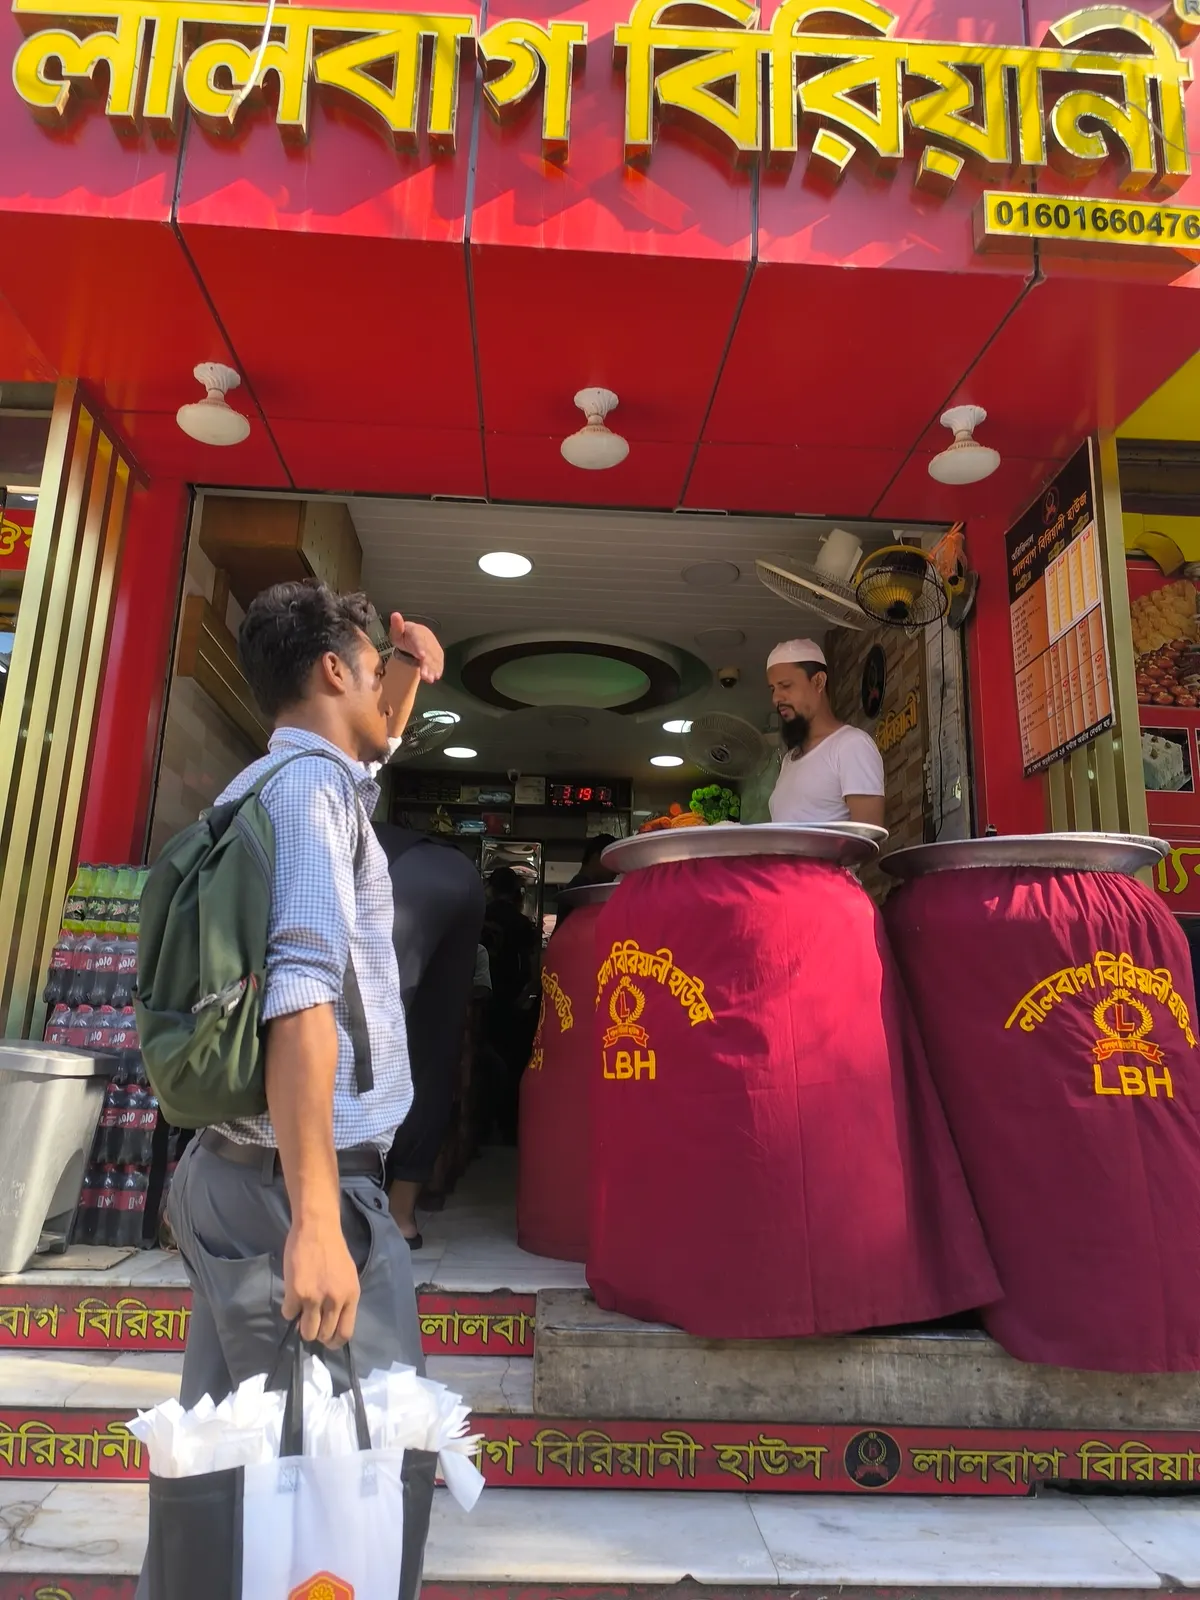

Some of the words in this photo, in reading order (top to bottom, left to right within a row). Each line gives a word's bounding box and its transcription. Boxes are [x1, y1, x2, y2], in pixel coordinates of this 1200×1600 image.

[11, 0, 588, 141] লালবাগ
[614, 0, 1193, 175] বিরিয়ানী
[996, 200, 1200, 240] 01601660476
[610, 940, 673, 985] বিরিয়ানী
[1004, 963, 1096, 1032] লালবাগ
[1094, 951, 1173, 1004] বিরিয়ানী
[602, 1050, 656, 1080] LBH
[1093, 1063, 1174, 1098] LBH
[531, 1429, 703, 1478] বিরিয়ানী
[712, 1434, 829, 1484] হাউস
[910, 1447, 1068, 1484] লালবাগ
[1075, 1440, 1200, 1481] বিরিয়া
